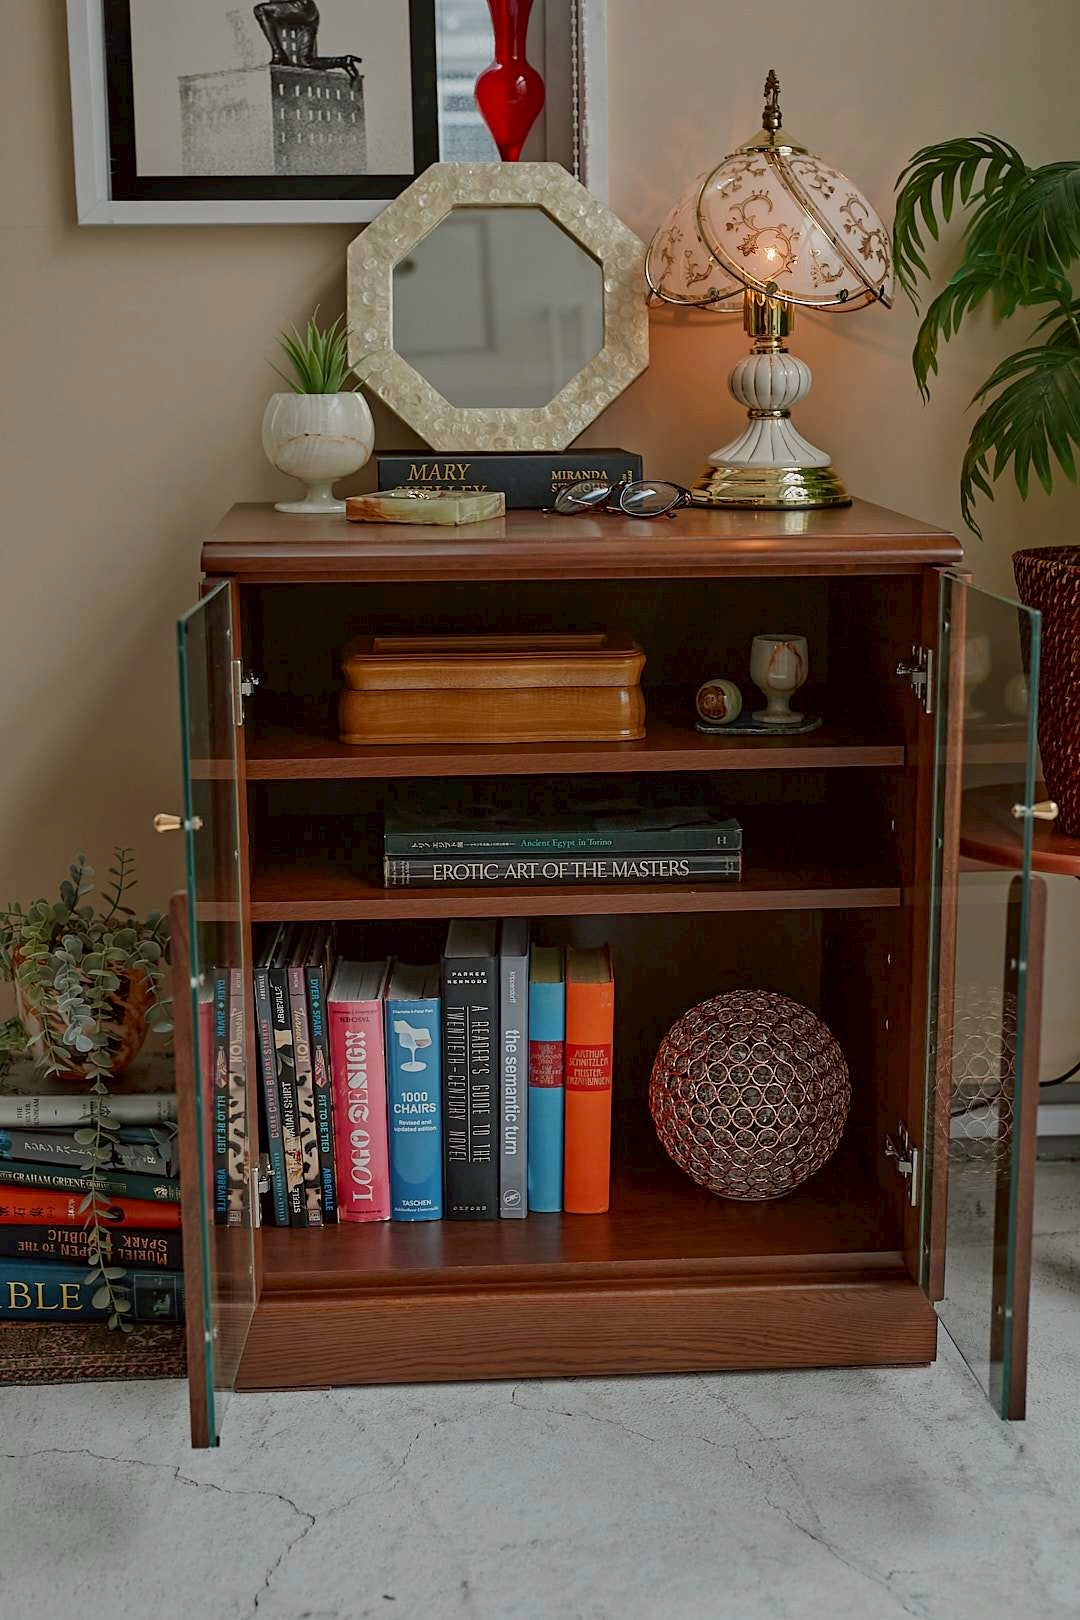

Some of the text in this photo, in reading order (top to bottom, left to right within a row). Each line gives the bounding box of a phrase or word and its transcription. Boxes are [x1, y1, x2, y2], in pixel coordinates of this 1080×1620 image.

[407, 463, 471, 481] MARY
[551, 470, 609, 480] MIRANDA
[520, 839, 549, 847] Ancient
[552, 838, 576, 848] Egypt
[578, 838, 586, 846] in
[588, 838, 613, 846] Torino
[433, 859, 690, 880] EROTIC ART OF THE MASTERS
[274, 986, 285, 1023] ABBEVILLE
[310, 978, 322, 1037] DYER SPARK
[471, 1021, 490, 1074] READER'S
[345, 1030, 369, 1125] DESIGN
[282, 1081, 293, 1109] SHIRT
[400, 1092, 428, 1102] 1000
[471, 1085, 490, 1115] GUIDE
[504, 1029, 521, 1156] the semantic turn
[393, 1103, 437, 1114] CHAIRS
[318, 1094, 330, 1153] FIT TO BE TIED
[472, 1124, 491, 1136] TO
[448, 1131, 467, 1162] NOVEL
[472, 1144, 491, 1162] THE
[350, 1129, 373, 1202] LOGO
[13, 1172, 51, 1185] GRAHAM
[52, 1176, 85, 1188] GREENE
[322, 1168, 333, 1211] ABBEVILLE
[292, 1187, 301, 1213] STEELE
[402, 1199, 432, 1207] TASCHEN
[17, 1241, 41, 1251] THE
[48, 1229, 97, 1245] UBLIC
[123, 1235, 168, 1252] SPARK
[42, 1242, 56, 1252] TO
[118, 1248, 168, 1265] MURIEL
[0, 1281, 83, 1310] BLE
